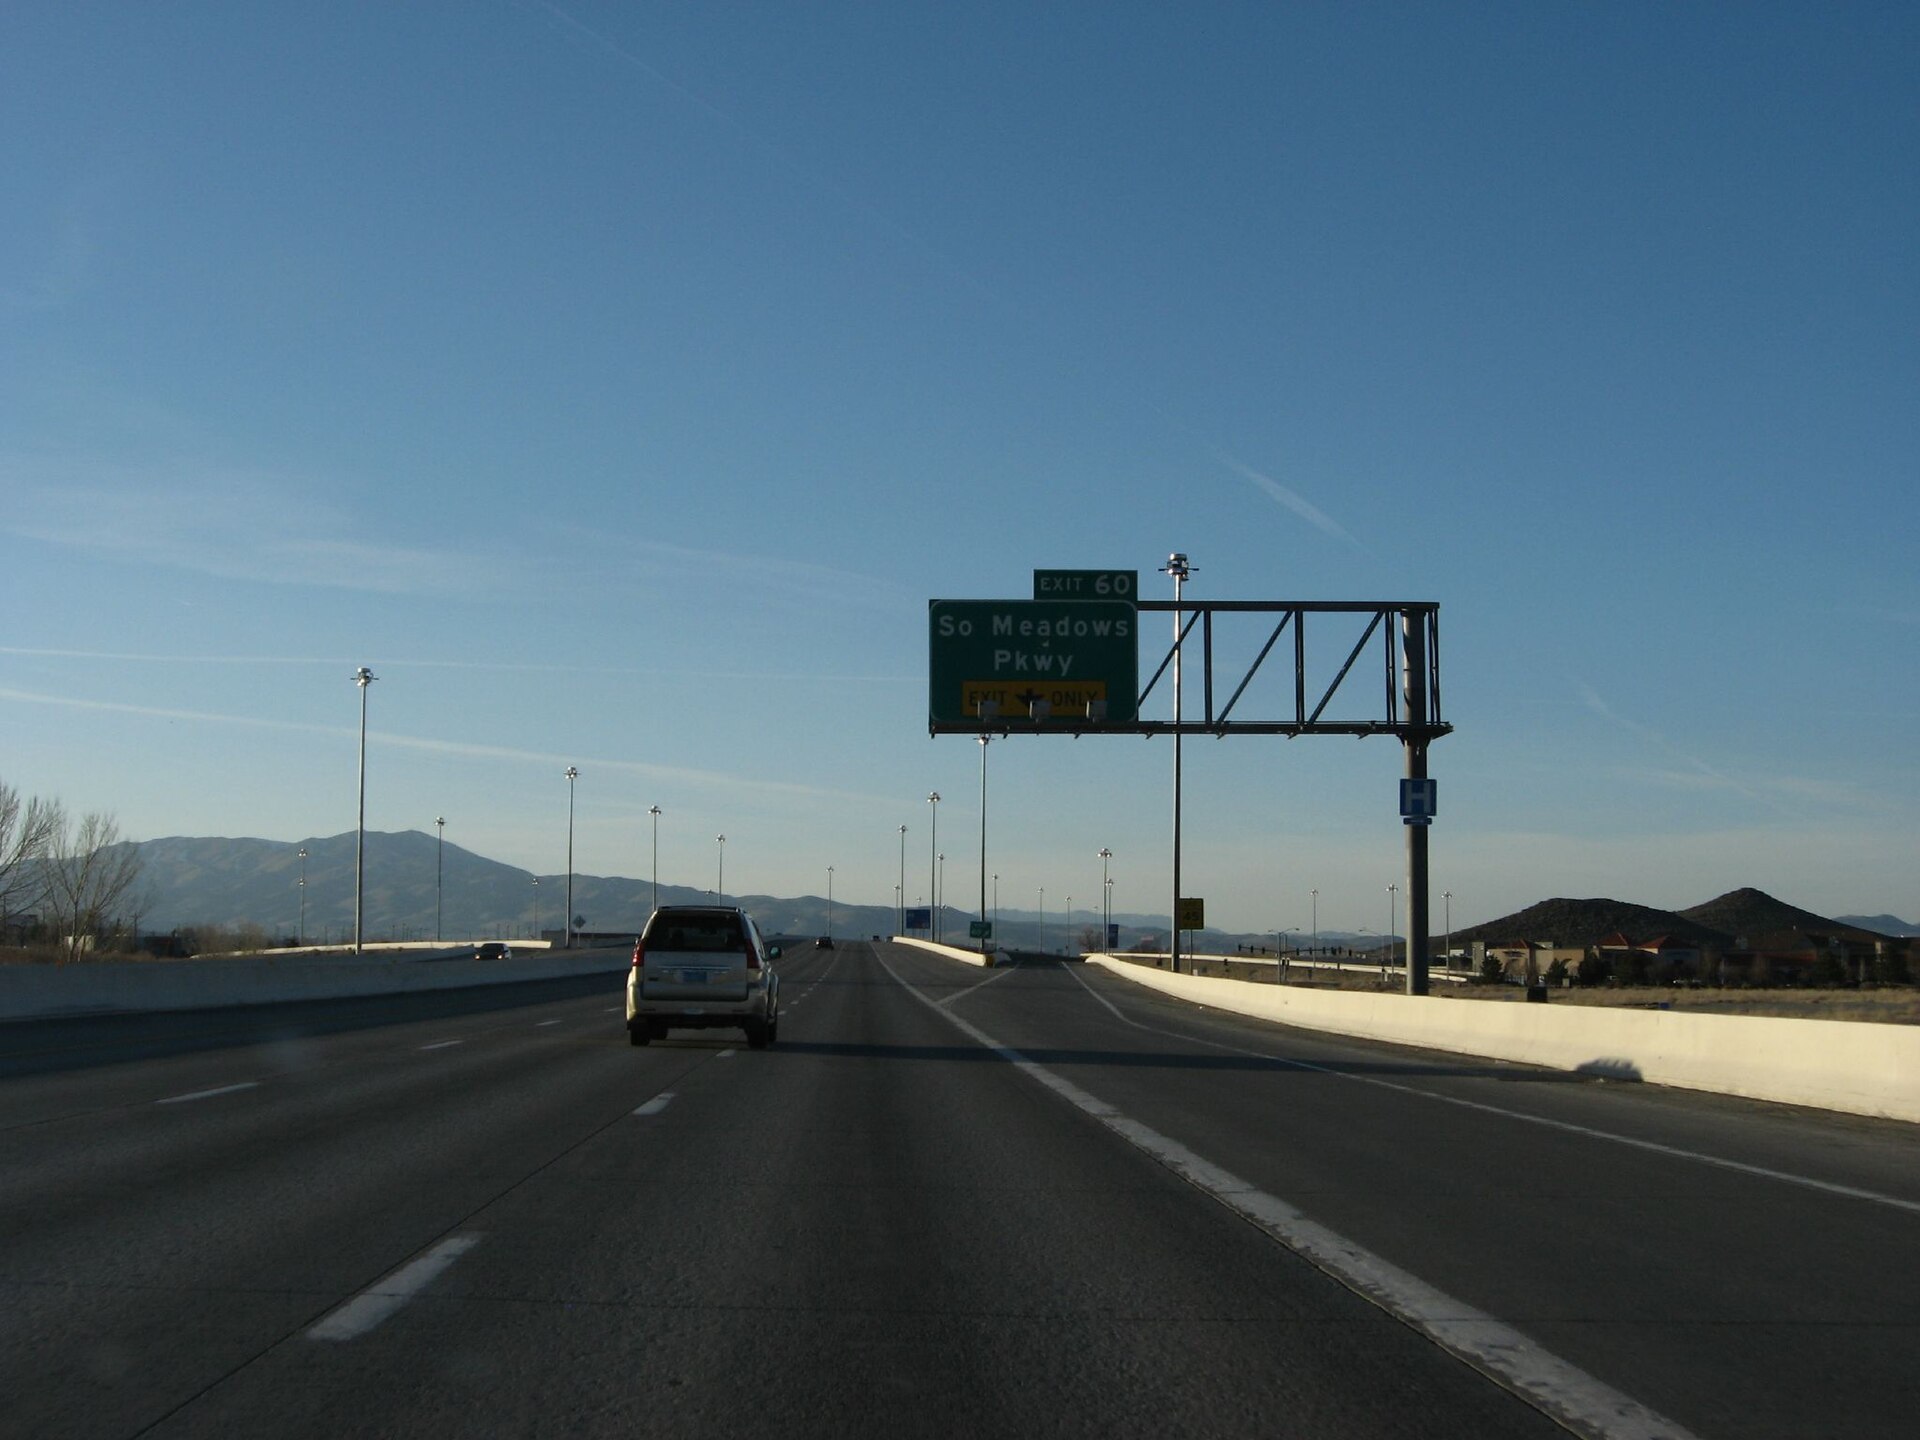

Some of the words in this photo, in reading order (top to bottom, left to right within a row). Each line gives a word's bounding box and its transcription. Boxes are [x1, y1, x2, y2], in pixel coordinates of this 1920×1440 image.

[1040, 577, 1083, 591] EXIT
[1094, 574, 1131, 594] 60
[938, 614, 973, 637] So
[992, 614, 1129, 637] Meadows
[993, 649, 1074, 677] Pkwy
[969, 690, 1008, 707] EXIT
[1051, 690, 1098, 707] ONLY
[1404, 780, 1431, 815] H
